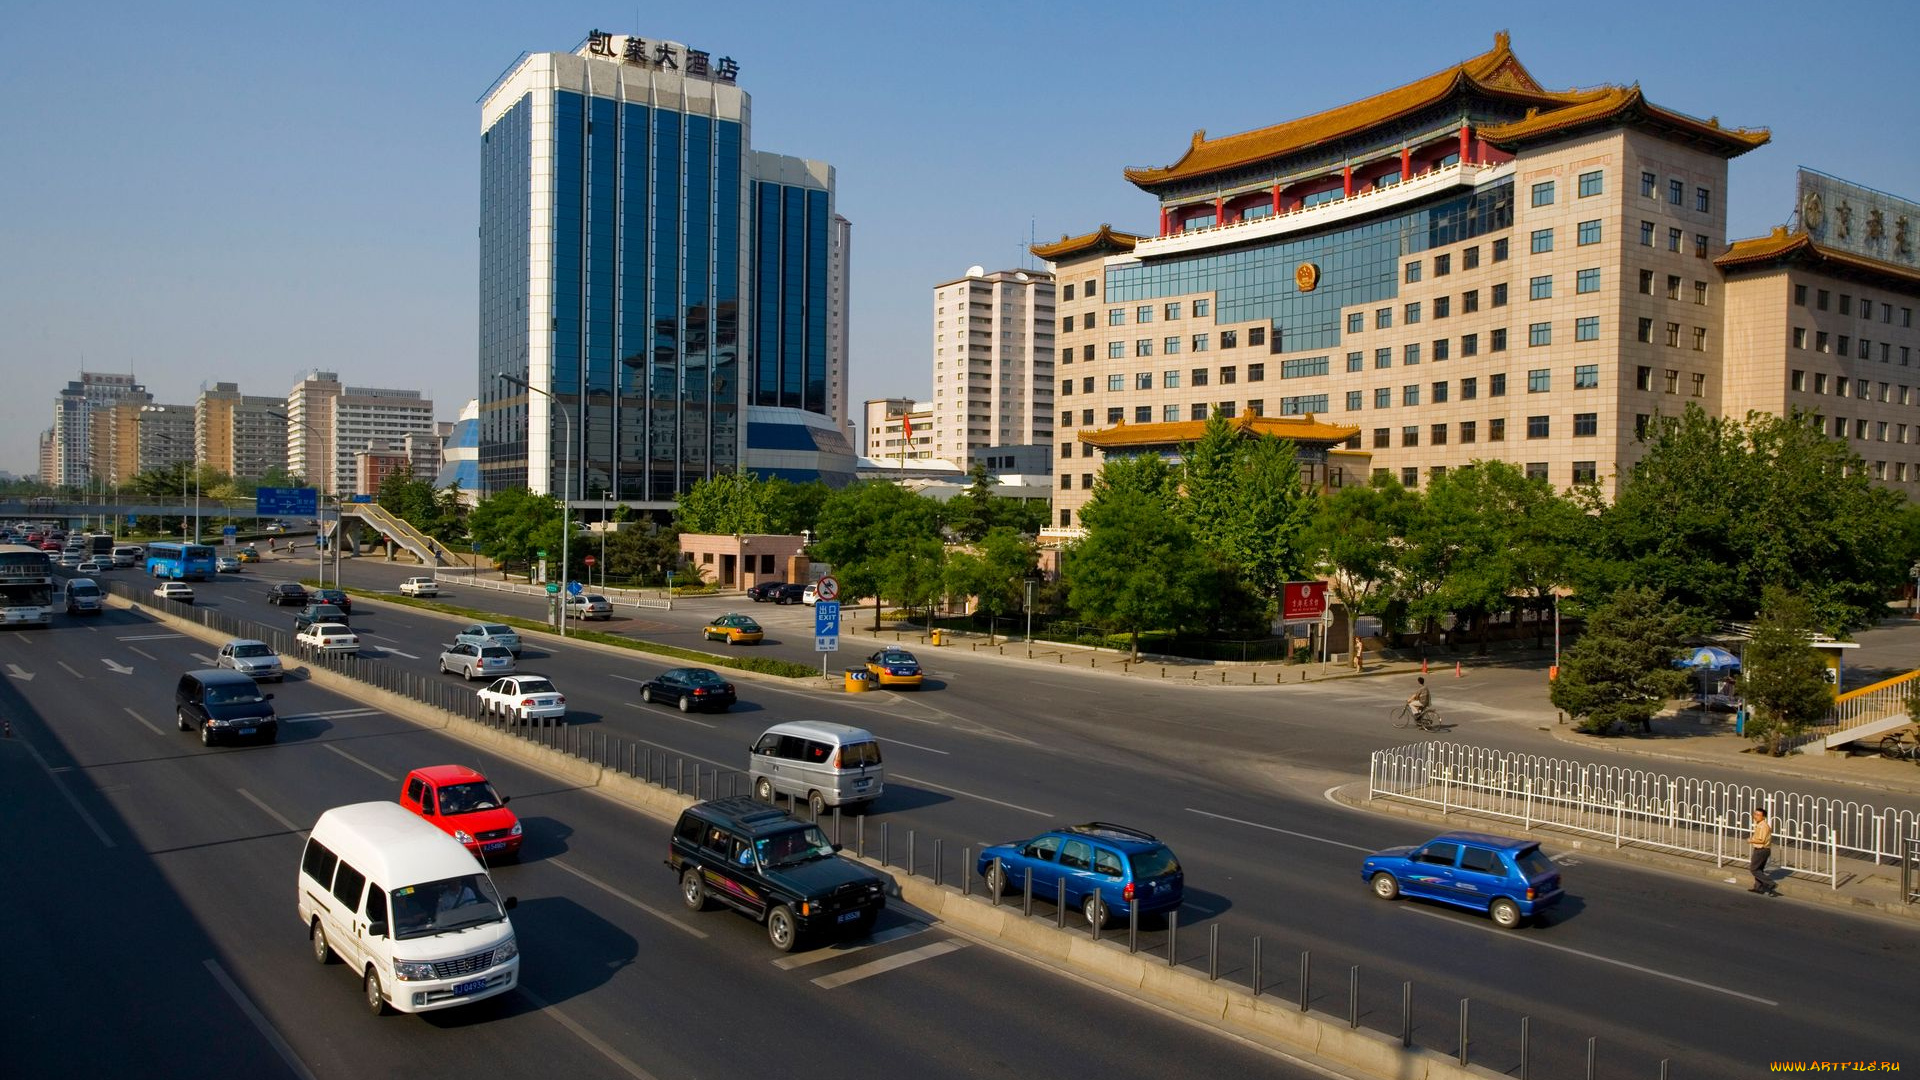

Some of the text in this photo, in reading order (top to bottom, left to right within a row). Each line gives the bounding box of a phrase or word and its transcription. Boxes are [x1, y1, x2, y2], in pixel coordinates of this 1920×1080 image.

[588, 28, 740, 82] 凯莱大酒店
[819, 605, 837, 614] 出口
